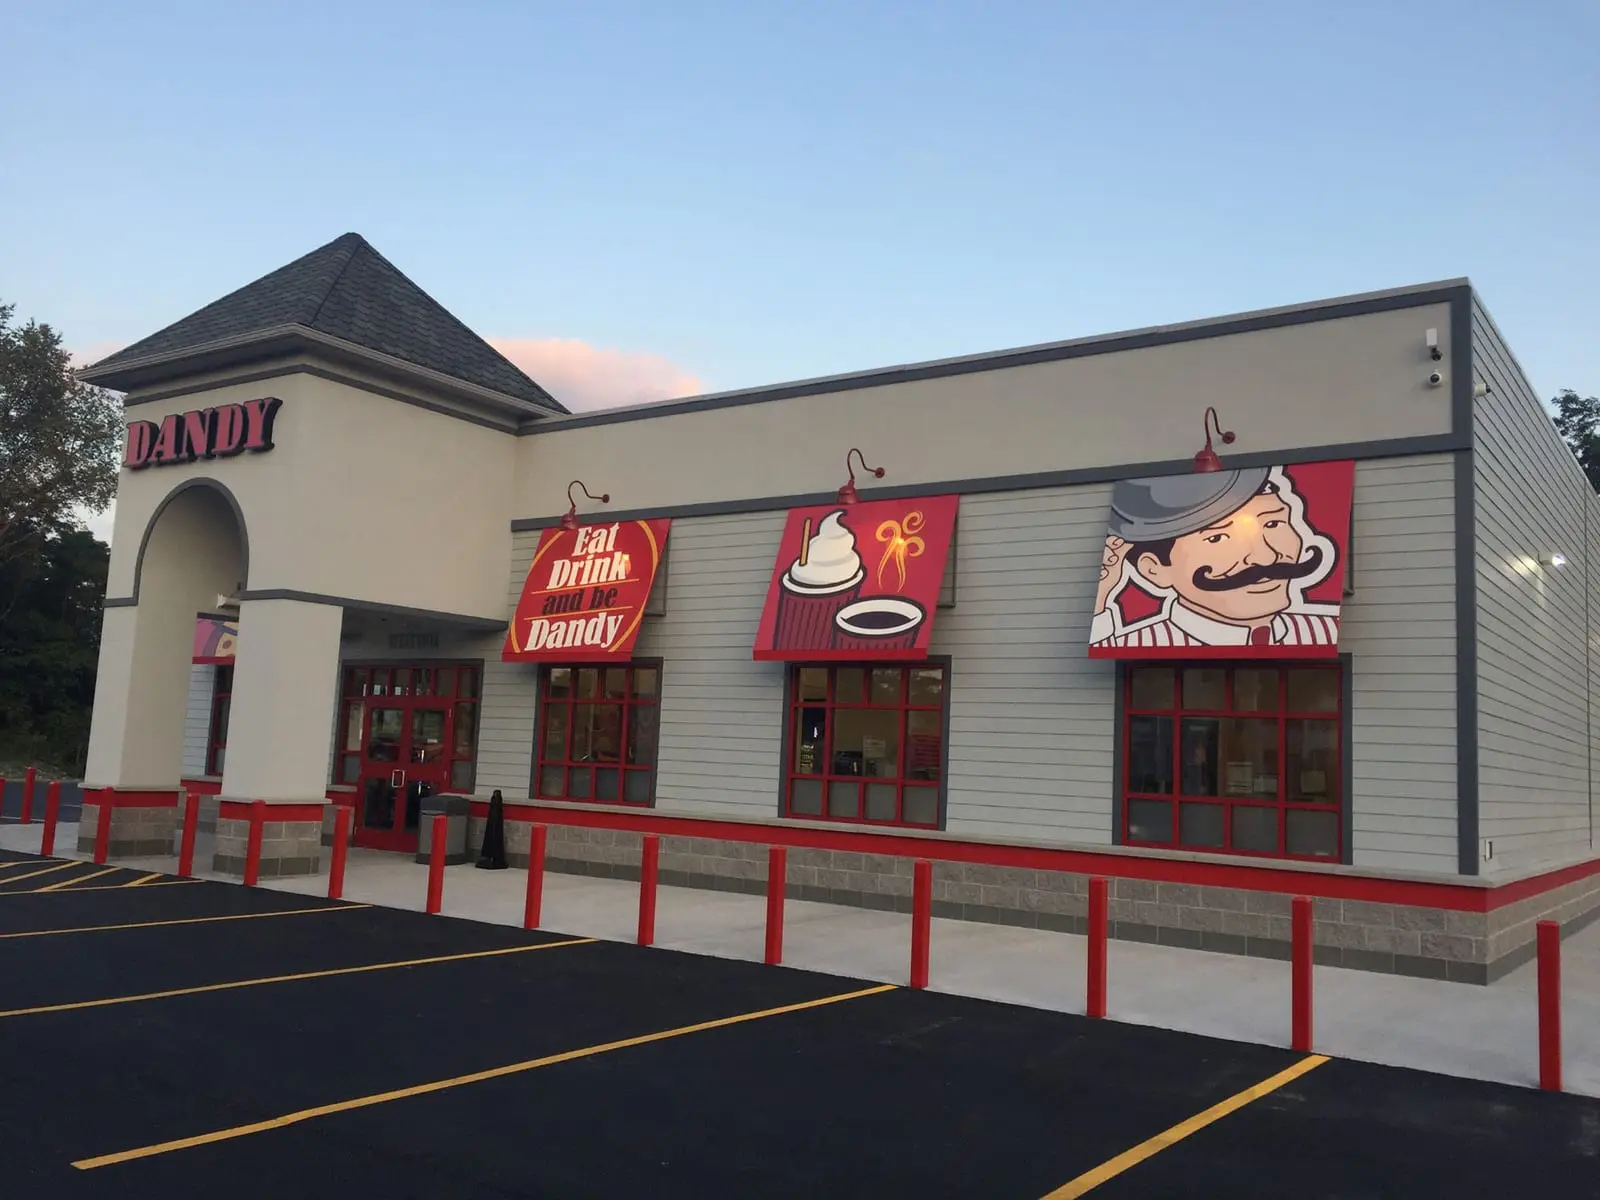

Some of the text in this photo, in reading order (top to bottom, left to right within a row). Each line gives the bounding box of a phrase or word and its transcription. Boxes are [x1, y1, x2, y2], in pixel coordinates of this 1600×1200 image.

[123, 397, 282, 469] DANDY
[572, 522, 620, 556] Eat
[546, 551, 629, 590] Drink
[541, 585, 618, 615] and be
[523, 612, 624, 651] Dandy
